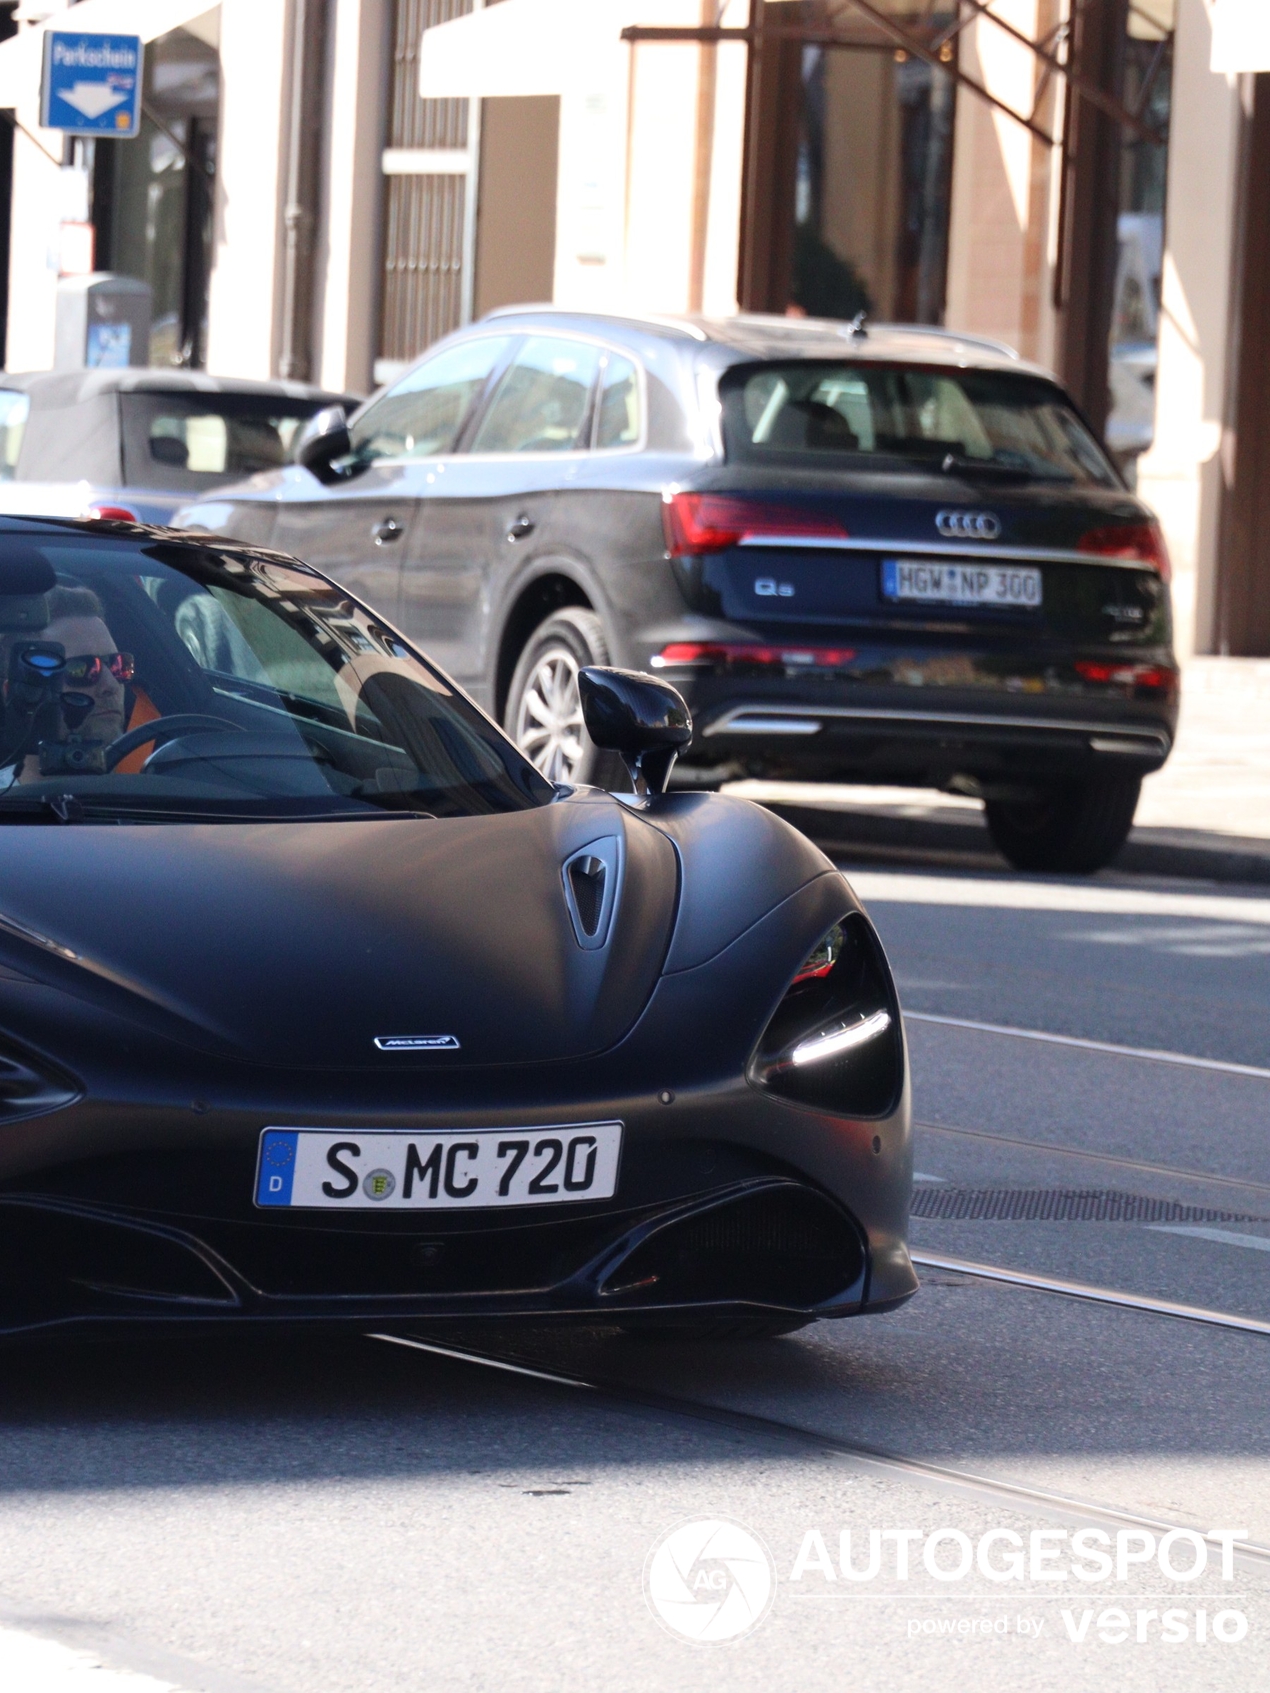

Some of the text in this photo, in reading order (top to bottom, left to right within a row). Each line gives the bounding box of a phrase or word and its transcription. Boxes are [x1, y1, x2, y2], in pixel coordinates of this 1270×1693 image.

[53, 41, 136, 68] Parkschein
[898, 566, 1036, 600] HGW NP 300
[321, 1135, 598, 1199] S MC 720
[268, 1175, 282, 1192] D
